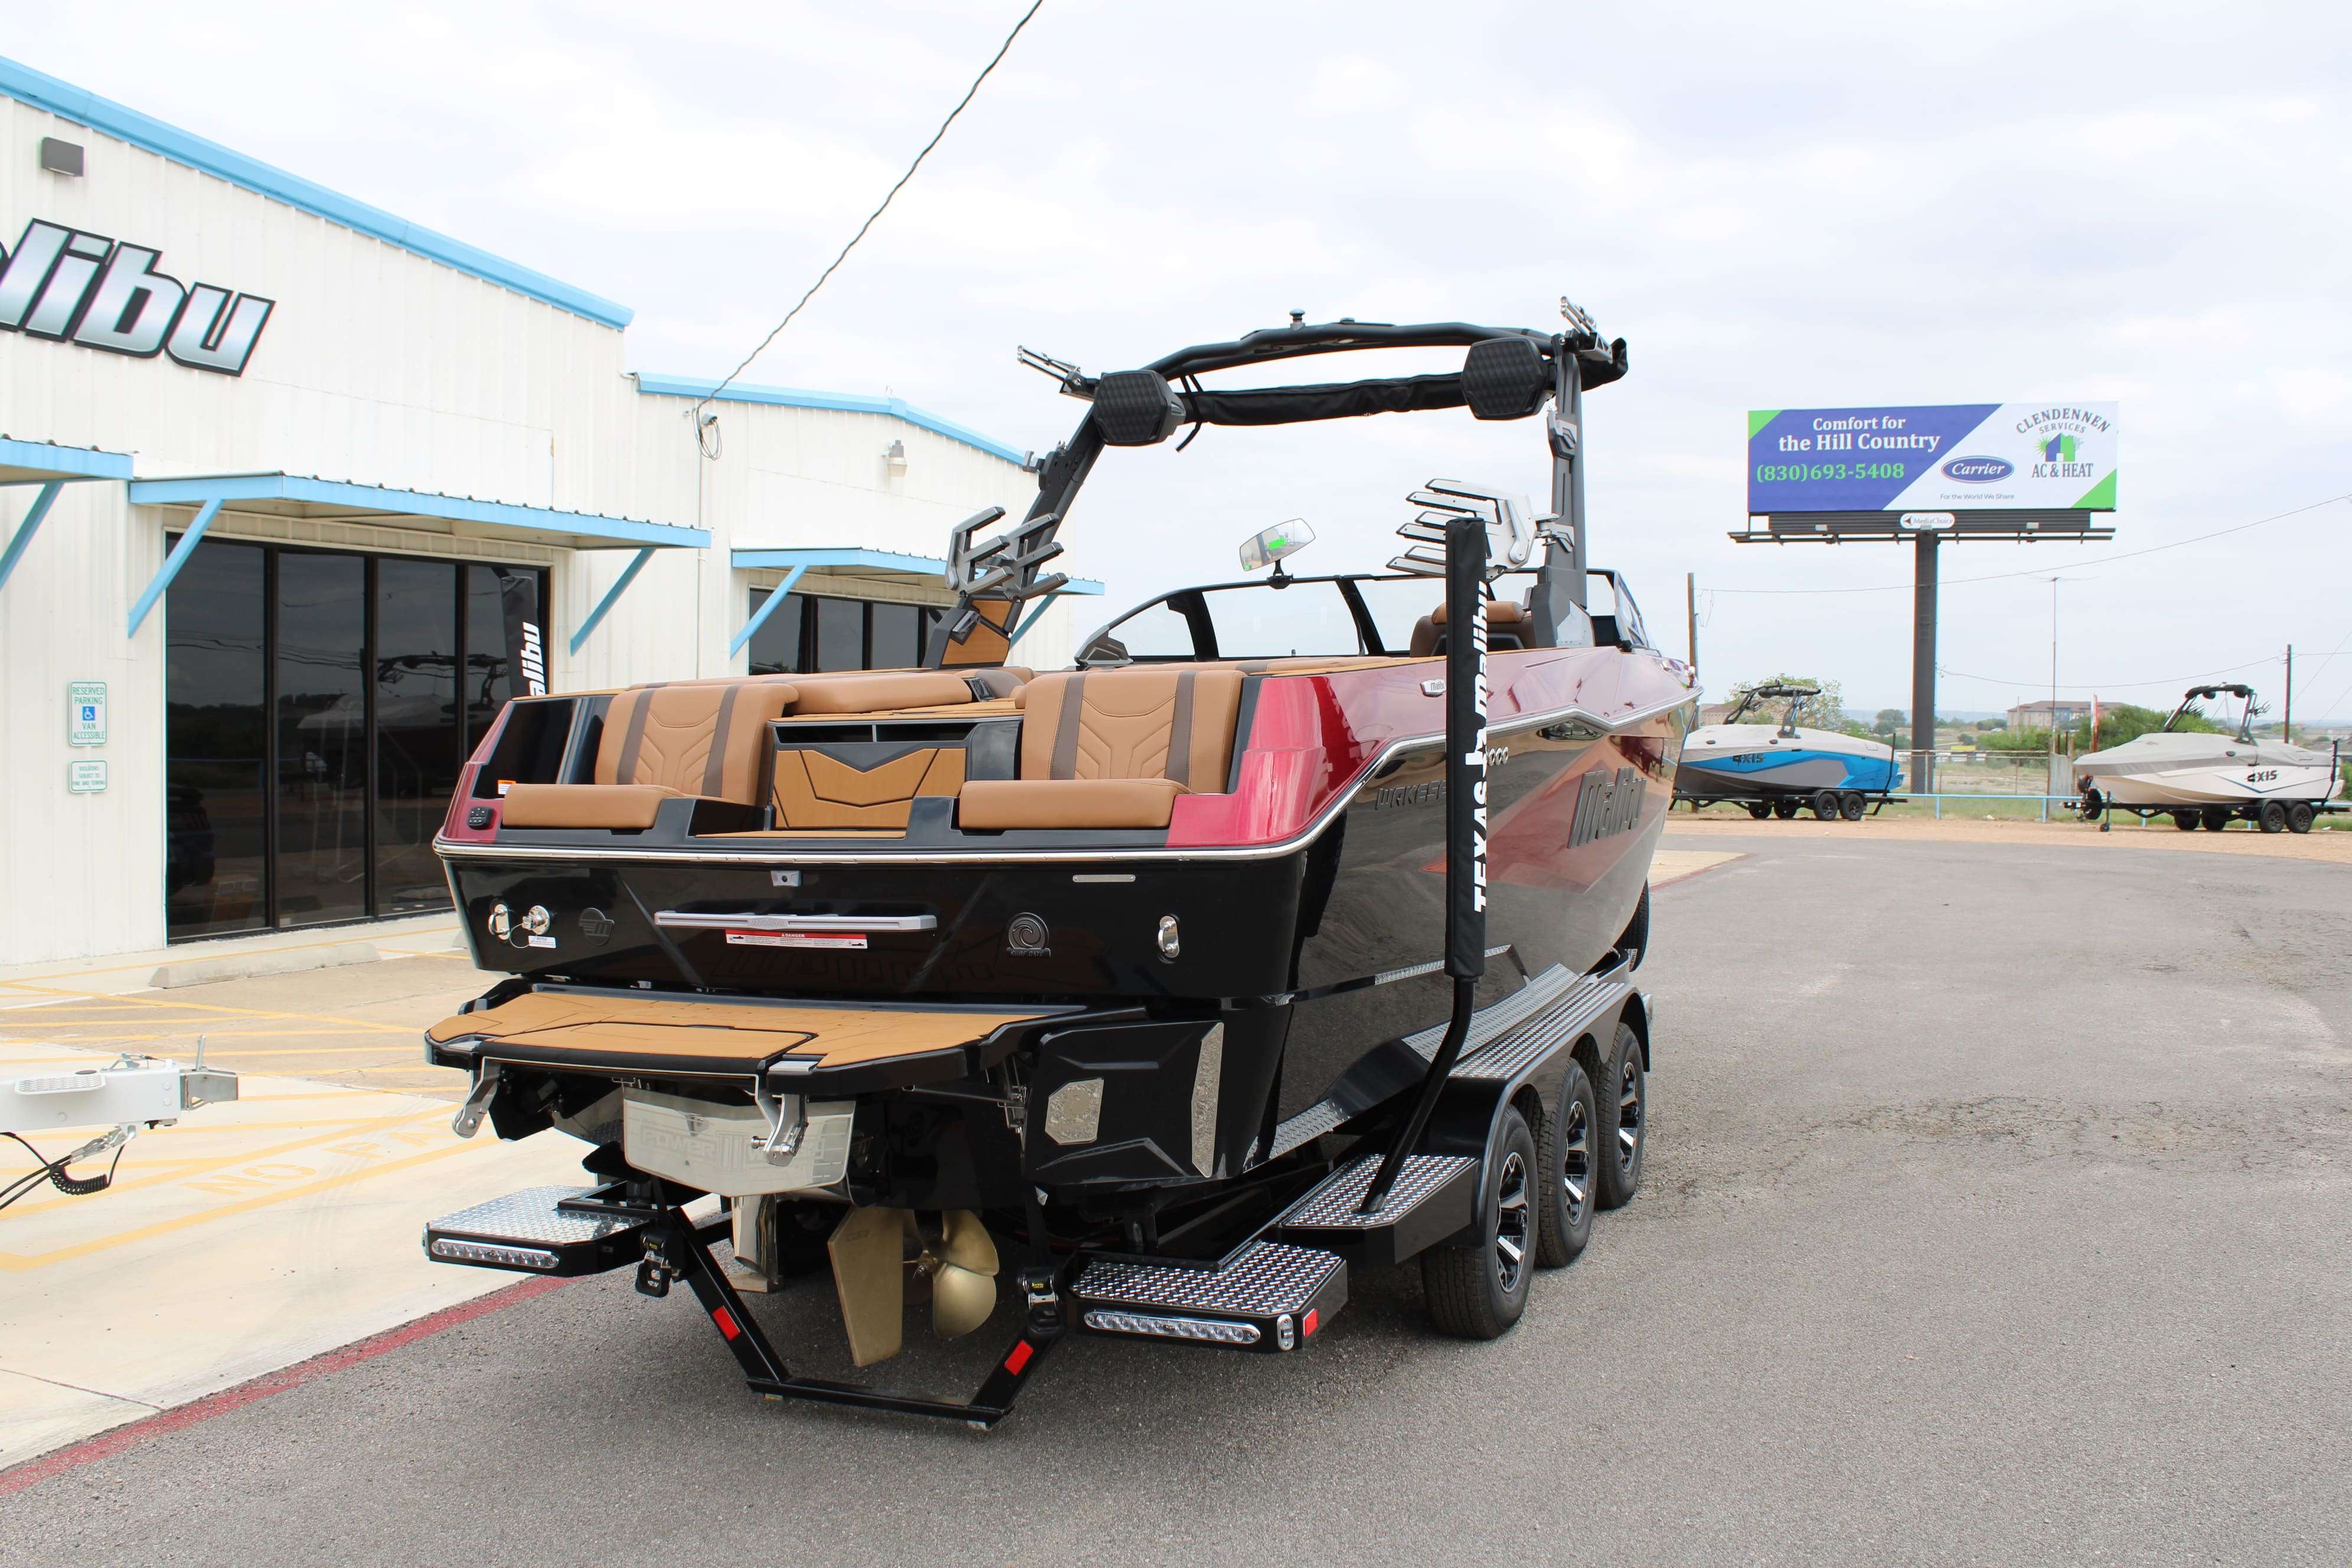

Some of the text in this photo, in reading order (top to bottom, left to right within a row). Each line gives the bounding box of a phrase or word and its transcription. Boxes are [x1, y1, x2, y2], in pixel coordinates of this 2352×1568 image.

[0, 218, 276, 377] libu
[1813, 416, 1906, 430] Comfort for
[2016, 408, 2111, 434] CLENDENNEN
[2039, 422, 2086, 435] SERVICES
[1779, 433, 1941, 453] the Hill Country
[1952, 462, 2005, 475] Carrier
[2031, 462, 2094, 478] AC & HEAT
[72, 687, 105, 695] RESERVED
[74, 697, 103, 705] PARKING
